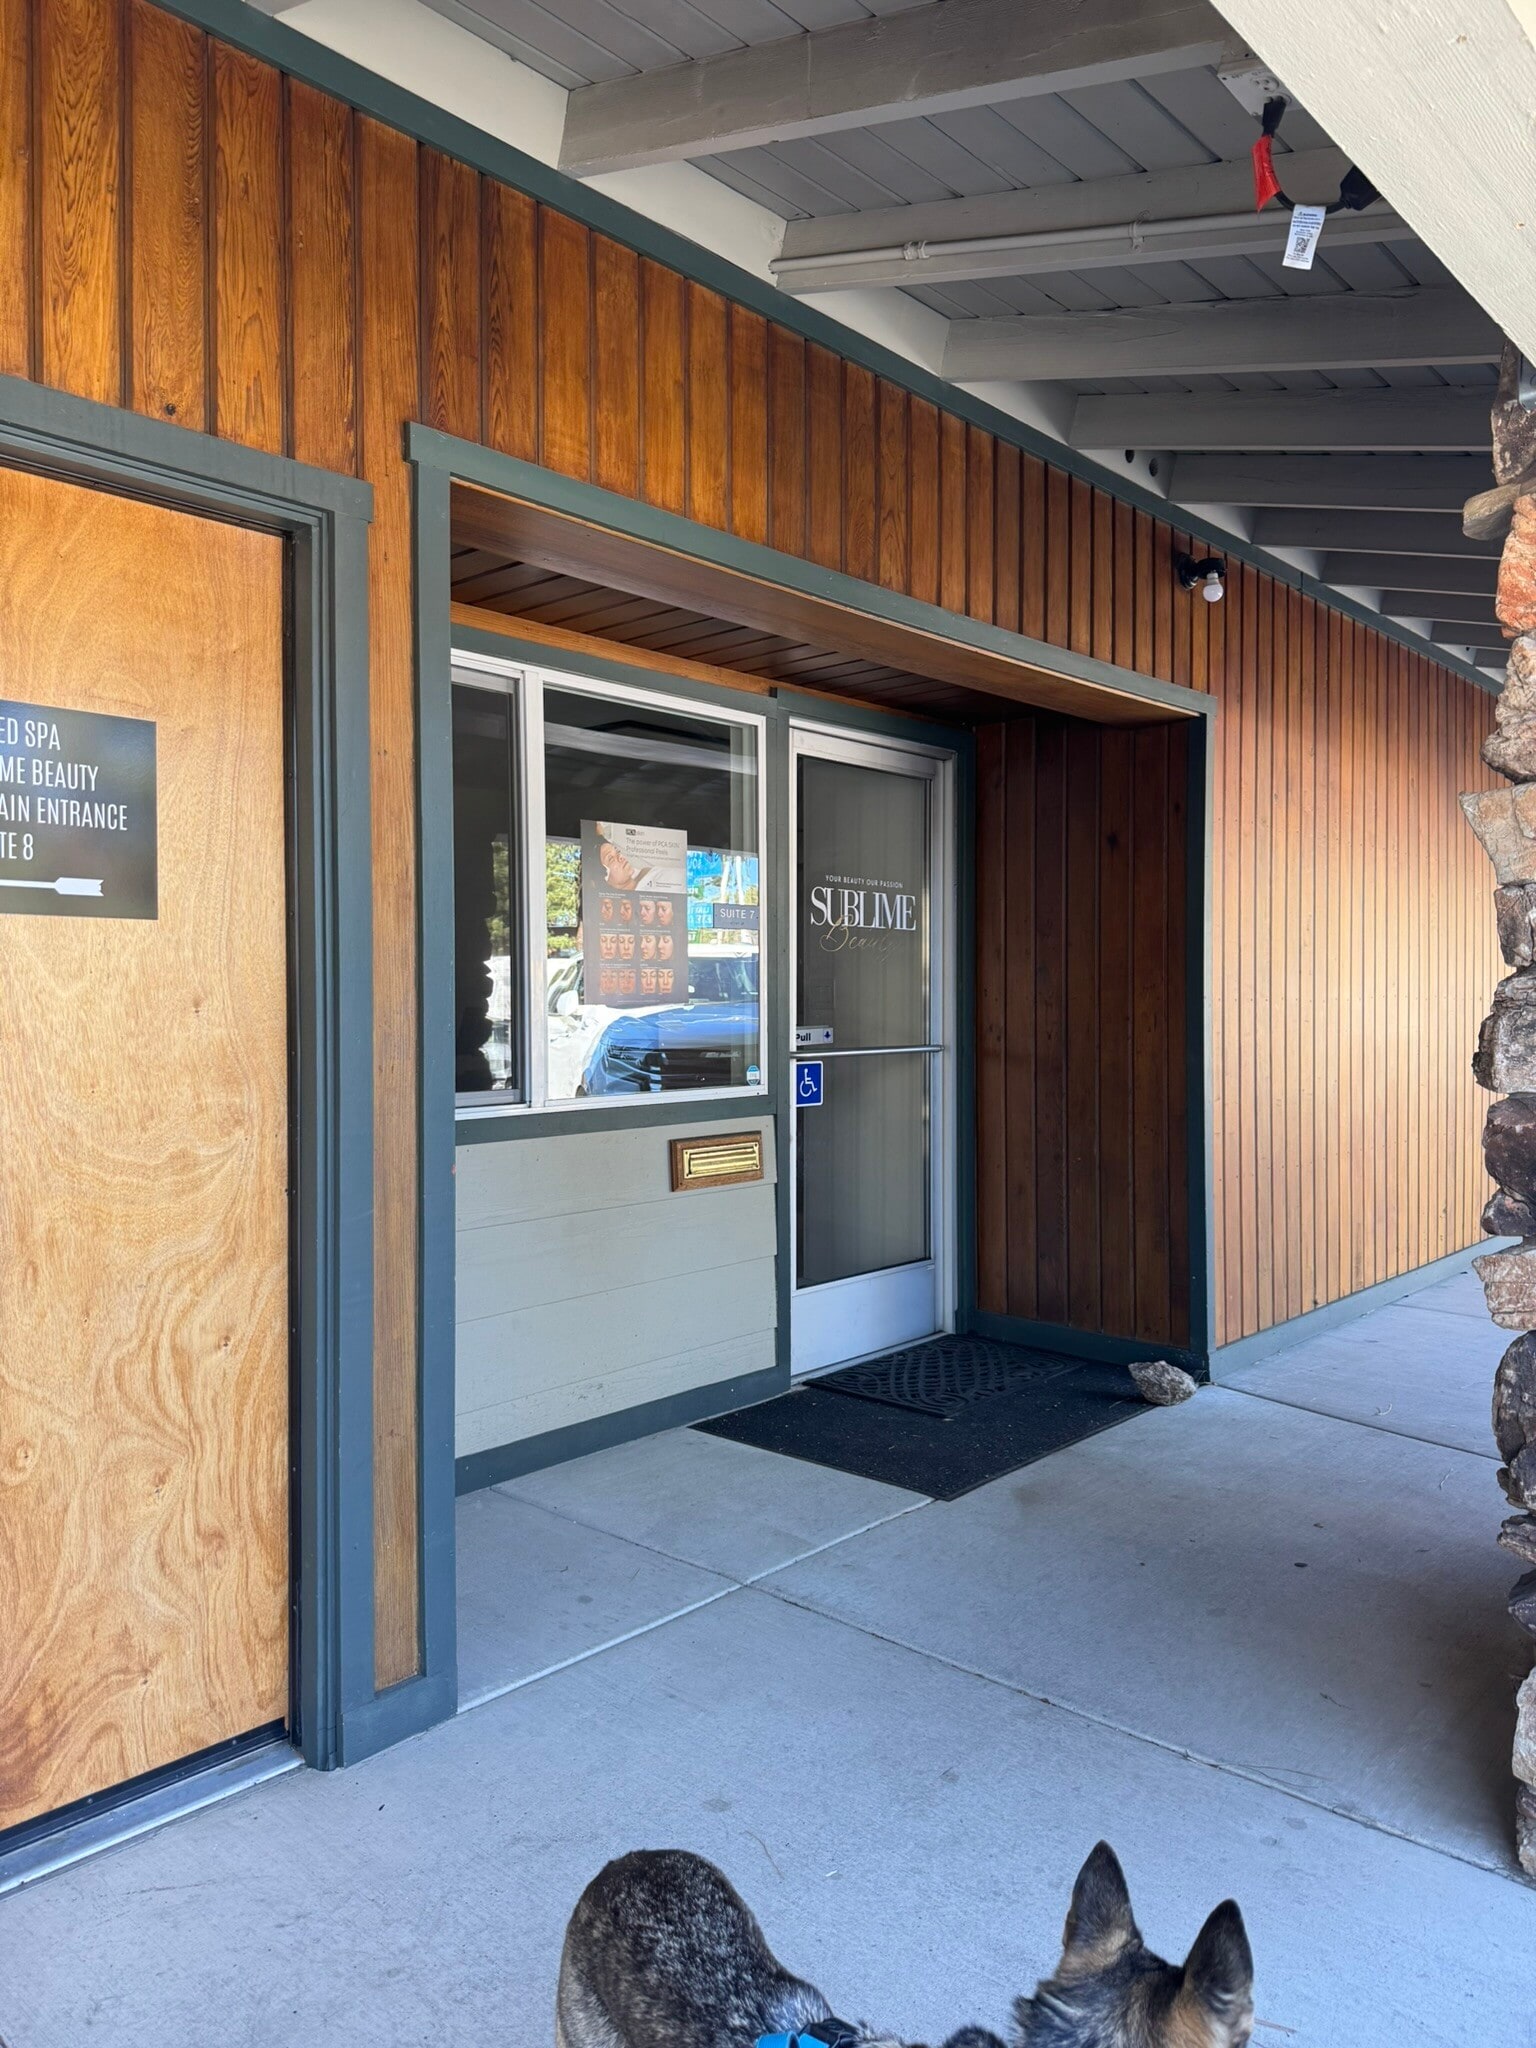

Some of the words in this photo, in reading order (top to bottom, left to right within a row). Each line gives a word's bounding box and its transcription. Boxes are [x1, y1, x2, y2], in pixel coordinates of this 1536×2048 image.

[25, 719, 61, 750] SPA
[32, 758, 99, 792] BEAUTY
[37, 797, 128, 831] ENTRANCE
[23, 833, 34, 860] 8
[825, 874, 841, 883] YOUR
[843, 876, 865, 885] BEAUTY
[866, 878, 878, 887] OUR
[880, 880, 903, 889] PASSION
[720, 908, 747, 919] SUITE
[749, 910, 755, 920] 7
[810, 886, 917, 931] SUBLIME
